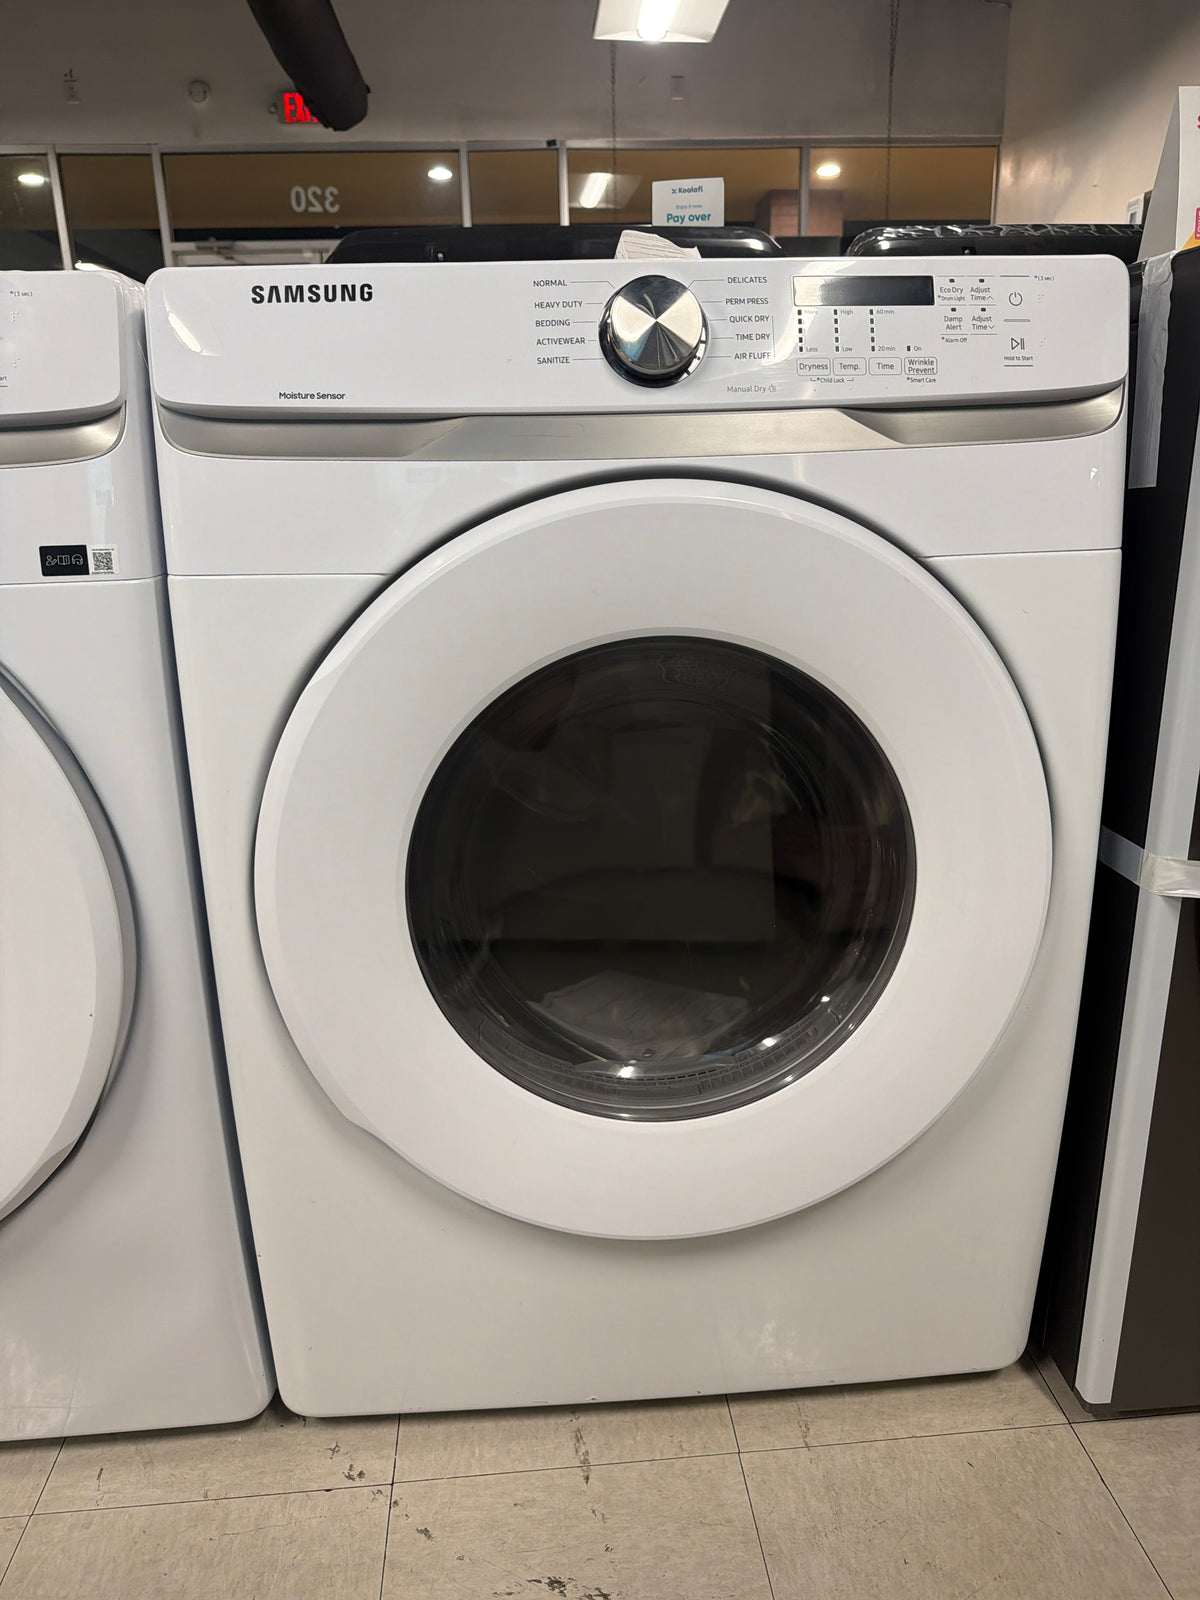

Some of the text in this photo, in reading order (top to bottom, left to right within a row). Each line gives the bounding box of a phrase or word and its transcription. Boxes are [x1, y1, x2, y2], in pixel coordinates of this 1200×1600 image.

[678, 186, 704, 194] Koalafi
[666, 212, 712, 224] Pay over
[533, 280, 568, 288] NORMAL
[251, 284, 374, 304] SAMSUNG
[730, 315, 770, 324] QUICK DRY
[535, 320, 570, 328] BEDDING
[536, 337, 586, 345] ACTIVEWEAR
[537, 356, 570, 364] SANITIZE
[800, 362, 828, 371] Dryness
[839, 362, 860, 371] Temp.
[754, 386, 766, 394] Dry
[278, 392, 346, 400] Moisture Sensor
